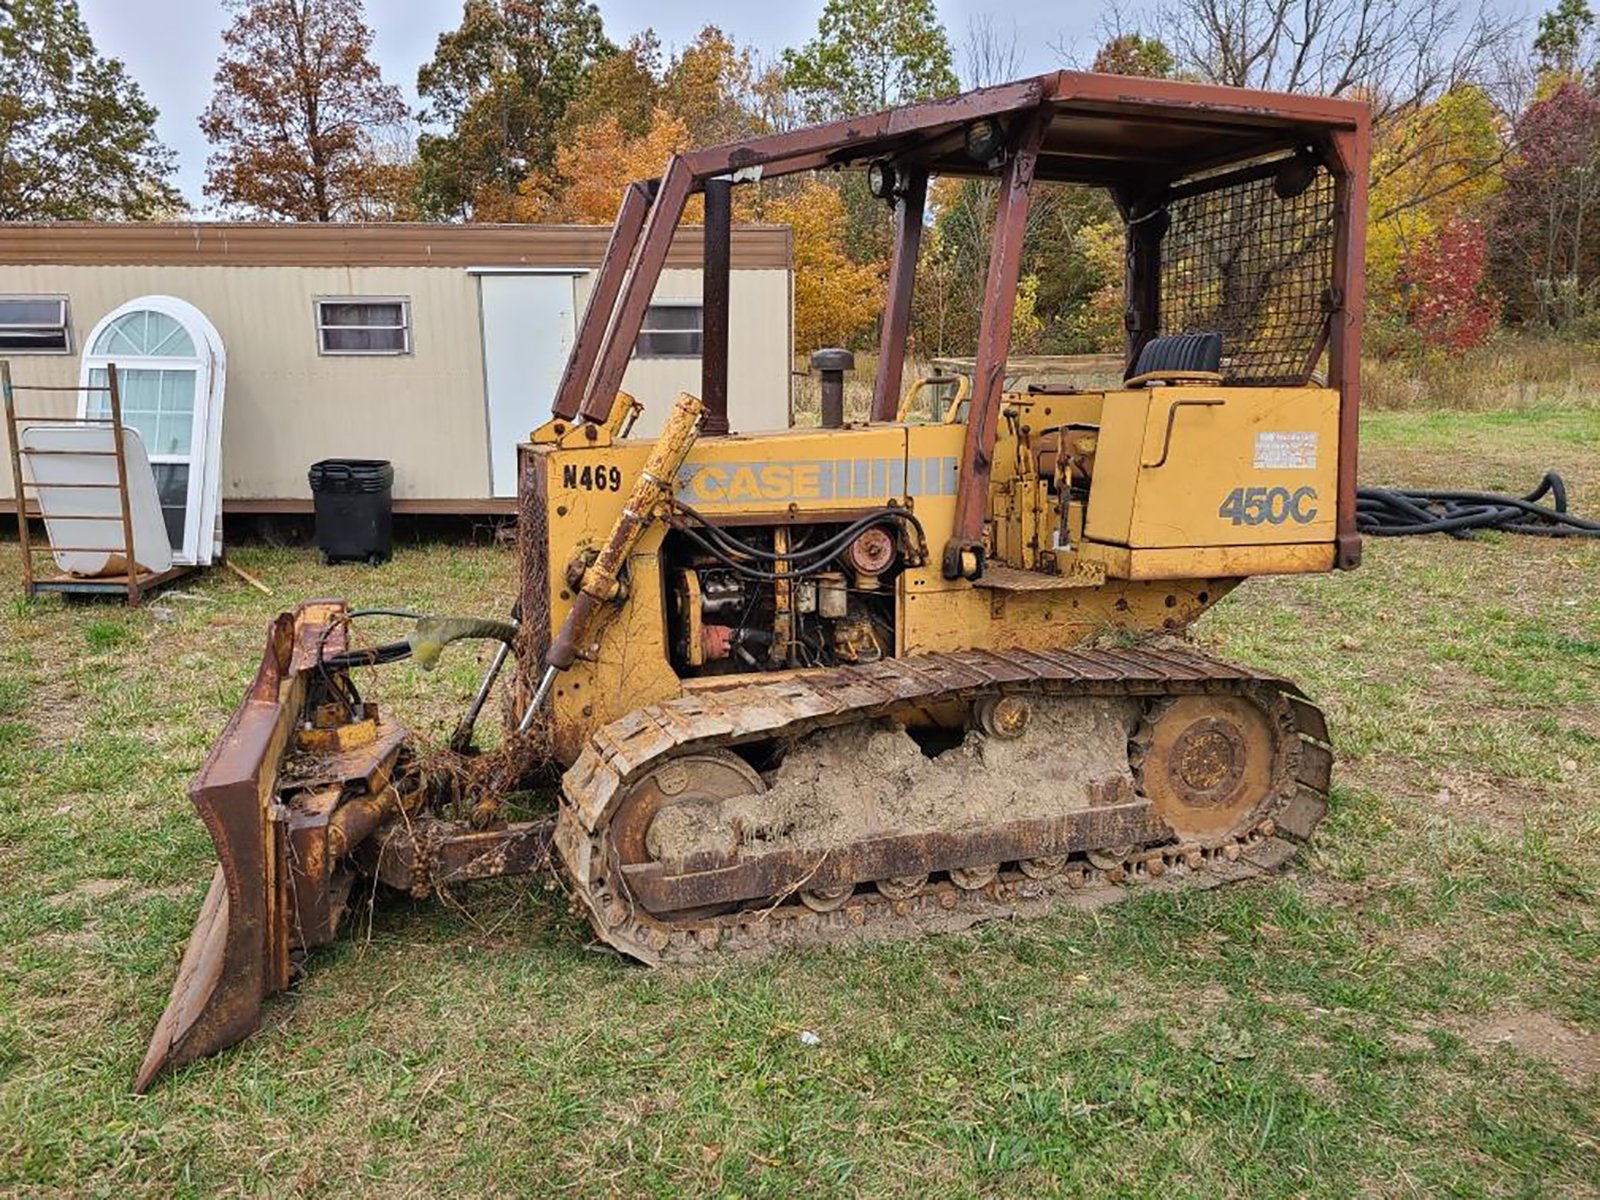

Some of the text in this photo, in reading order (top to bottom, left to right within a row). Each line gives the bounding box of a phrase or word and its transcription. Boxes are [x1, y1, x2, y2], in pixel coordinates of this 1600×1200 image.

[563, 464, 621, 492] N469
[692, 464, 820, 499] CASE
[1219, 486, 1318, 525] 450C
